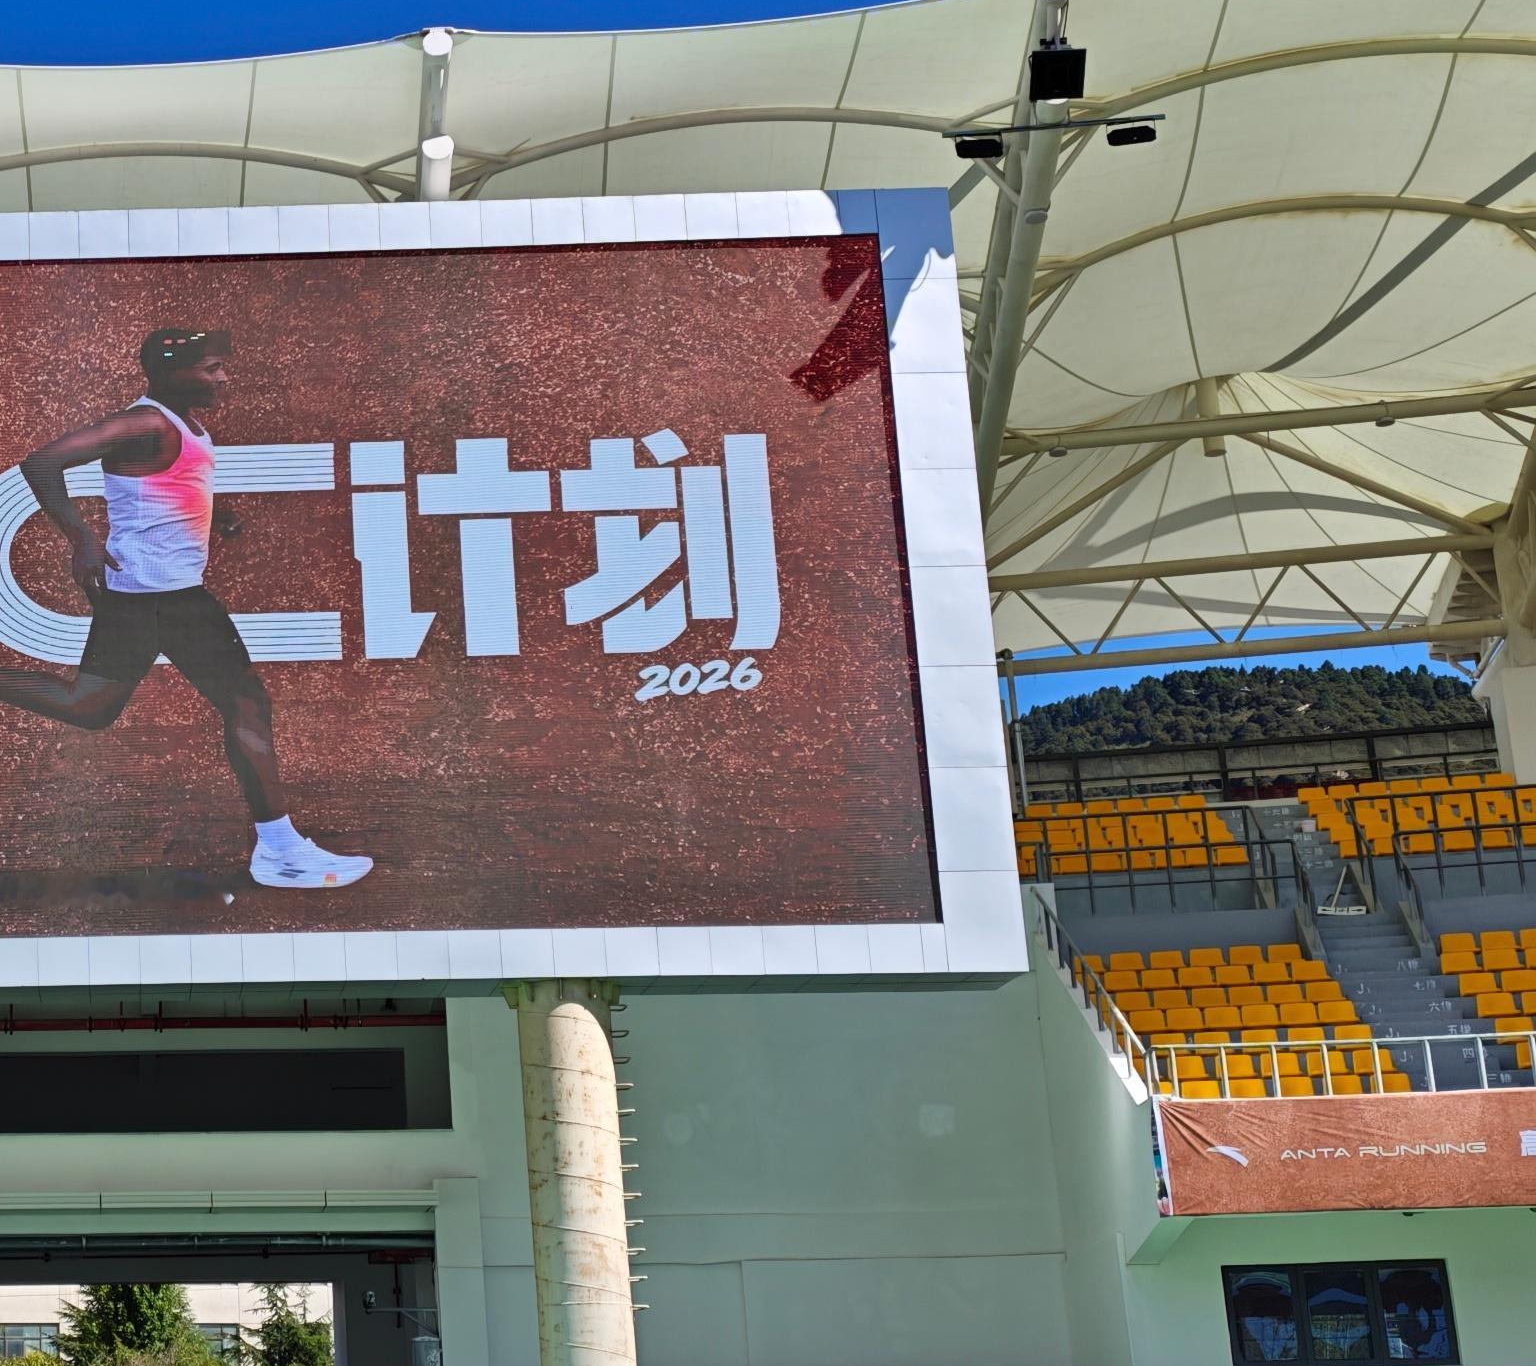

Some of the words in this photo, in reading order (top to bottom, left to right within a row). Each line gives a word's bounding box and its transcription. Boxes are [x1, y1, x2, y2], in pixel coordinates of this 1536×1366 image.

[634, 656, 764, 702] 2026
[1280, 1147, 1352, 1160] ANTA
[1359, 1142, 1487, 1158] RUNNING
